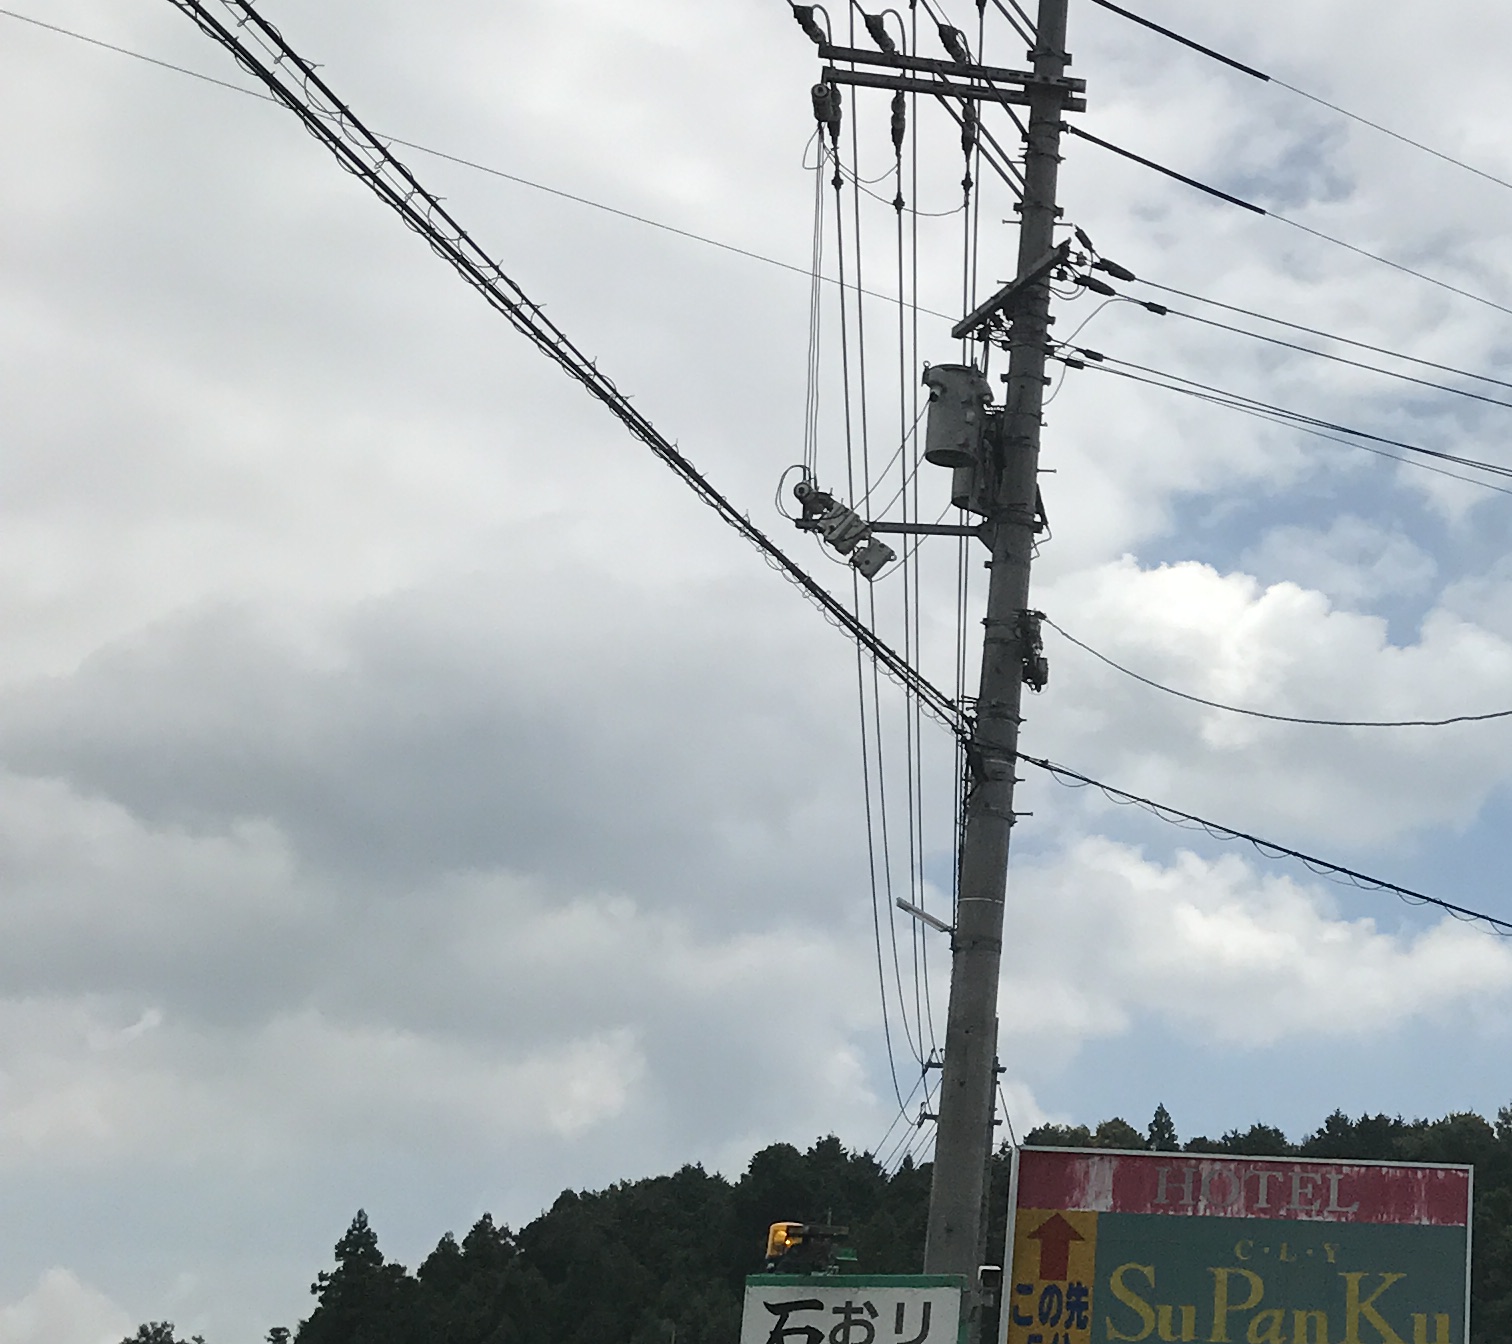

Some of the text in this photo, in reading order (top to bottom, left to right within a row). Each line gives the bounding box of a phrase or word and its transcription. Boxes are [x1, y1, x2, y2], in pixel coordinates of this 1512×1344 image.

[1154, 1165, 1361, 1214] HOTEL
[1011, 1281, 1091, 1330] この先
